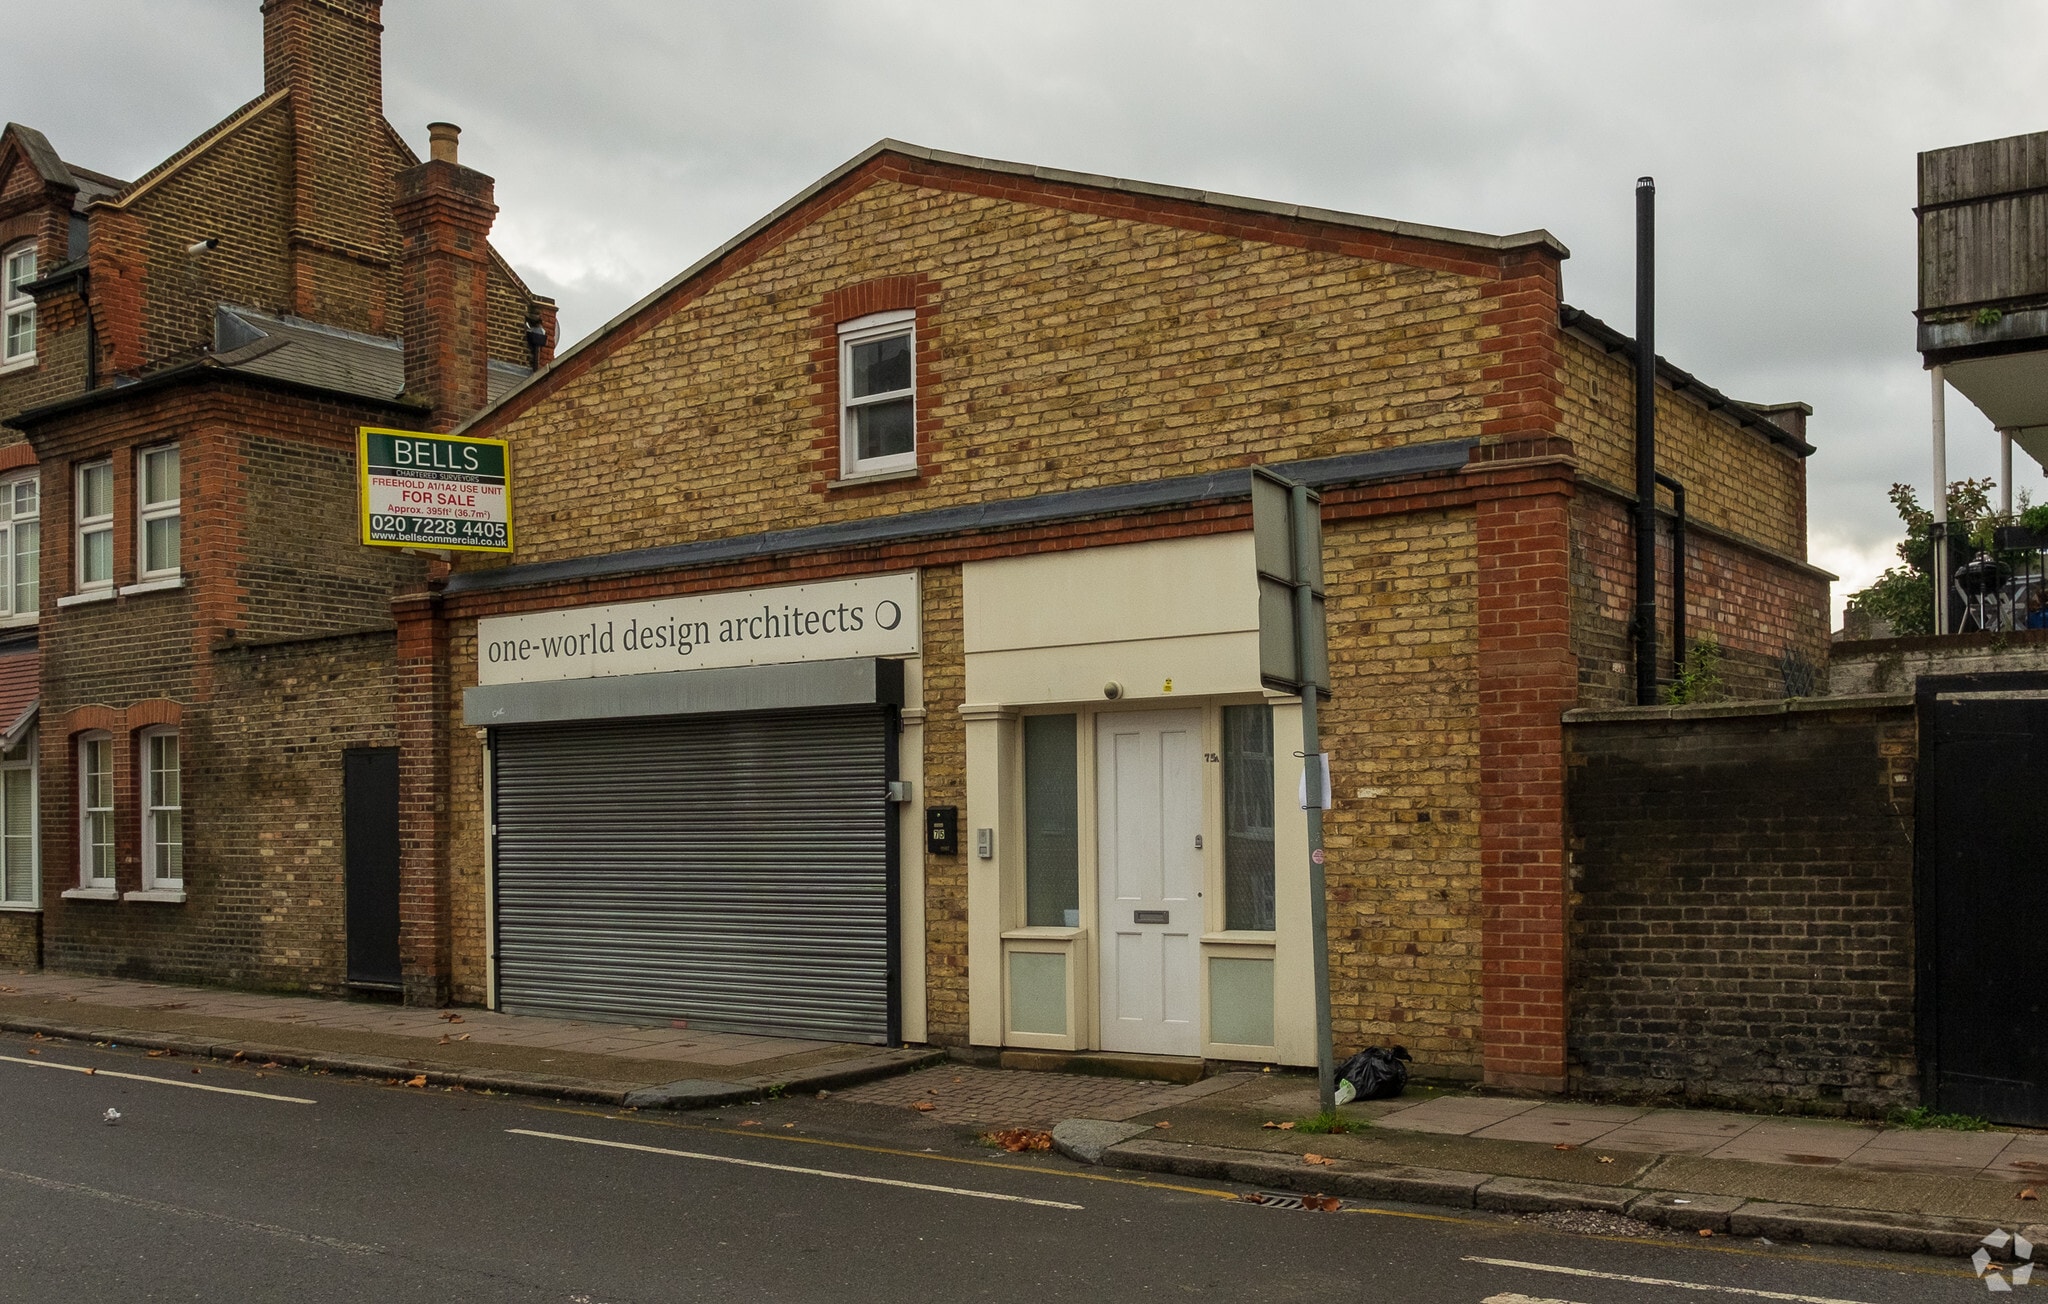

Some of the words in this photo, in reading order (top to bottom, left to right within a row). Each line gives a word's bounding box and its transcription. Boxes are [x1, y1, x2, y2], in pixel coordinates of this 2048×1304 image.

[394, 439, 479, 471] BELLS
[396, 469, 437, 480] CHARTERED
[439, 473, 480, 483] SURVEYORS
[372, 477, 425, 490] FREEHOLD
[427, 482, 457, 492] A1/1A2
[460, 486, 478, 494] USE
[481, 486, 502, 495] UNIT
[402, 490, 433, 504] FOR
[437, 493, 476, 507] SALE
[387, 504, 424, 515] Approx.
[372, 515, 406, 532] 020
[412, 518, 457, 535] 7228
[462, 521, 506, 538] 4405
[371, 532, 507, 547] www.bellscommercial.co.uk
[488, 622, 615, 663] one-world
[622, 617, 710, 655] design
[718, 602, 865, 641] architects
[933, 829, 945, 839] 75
